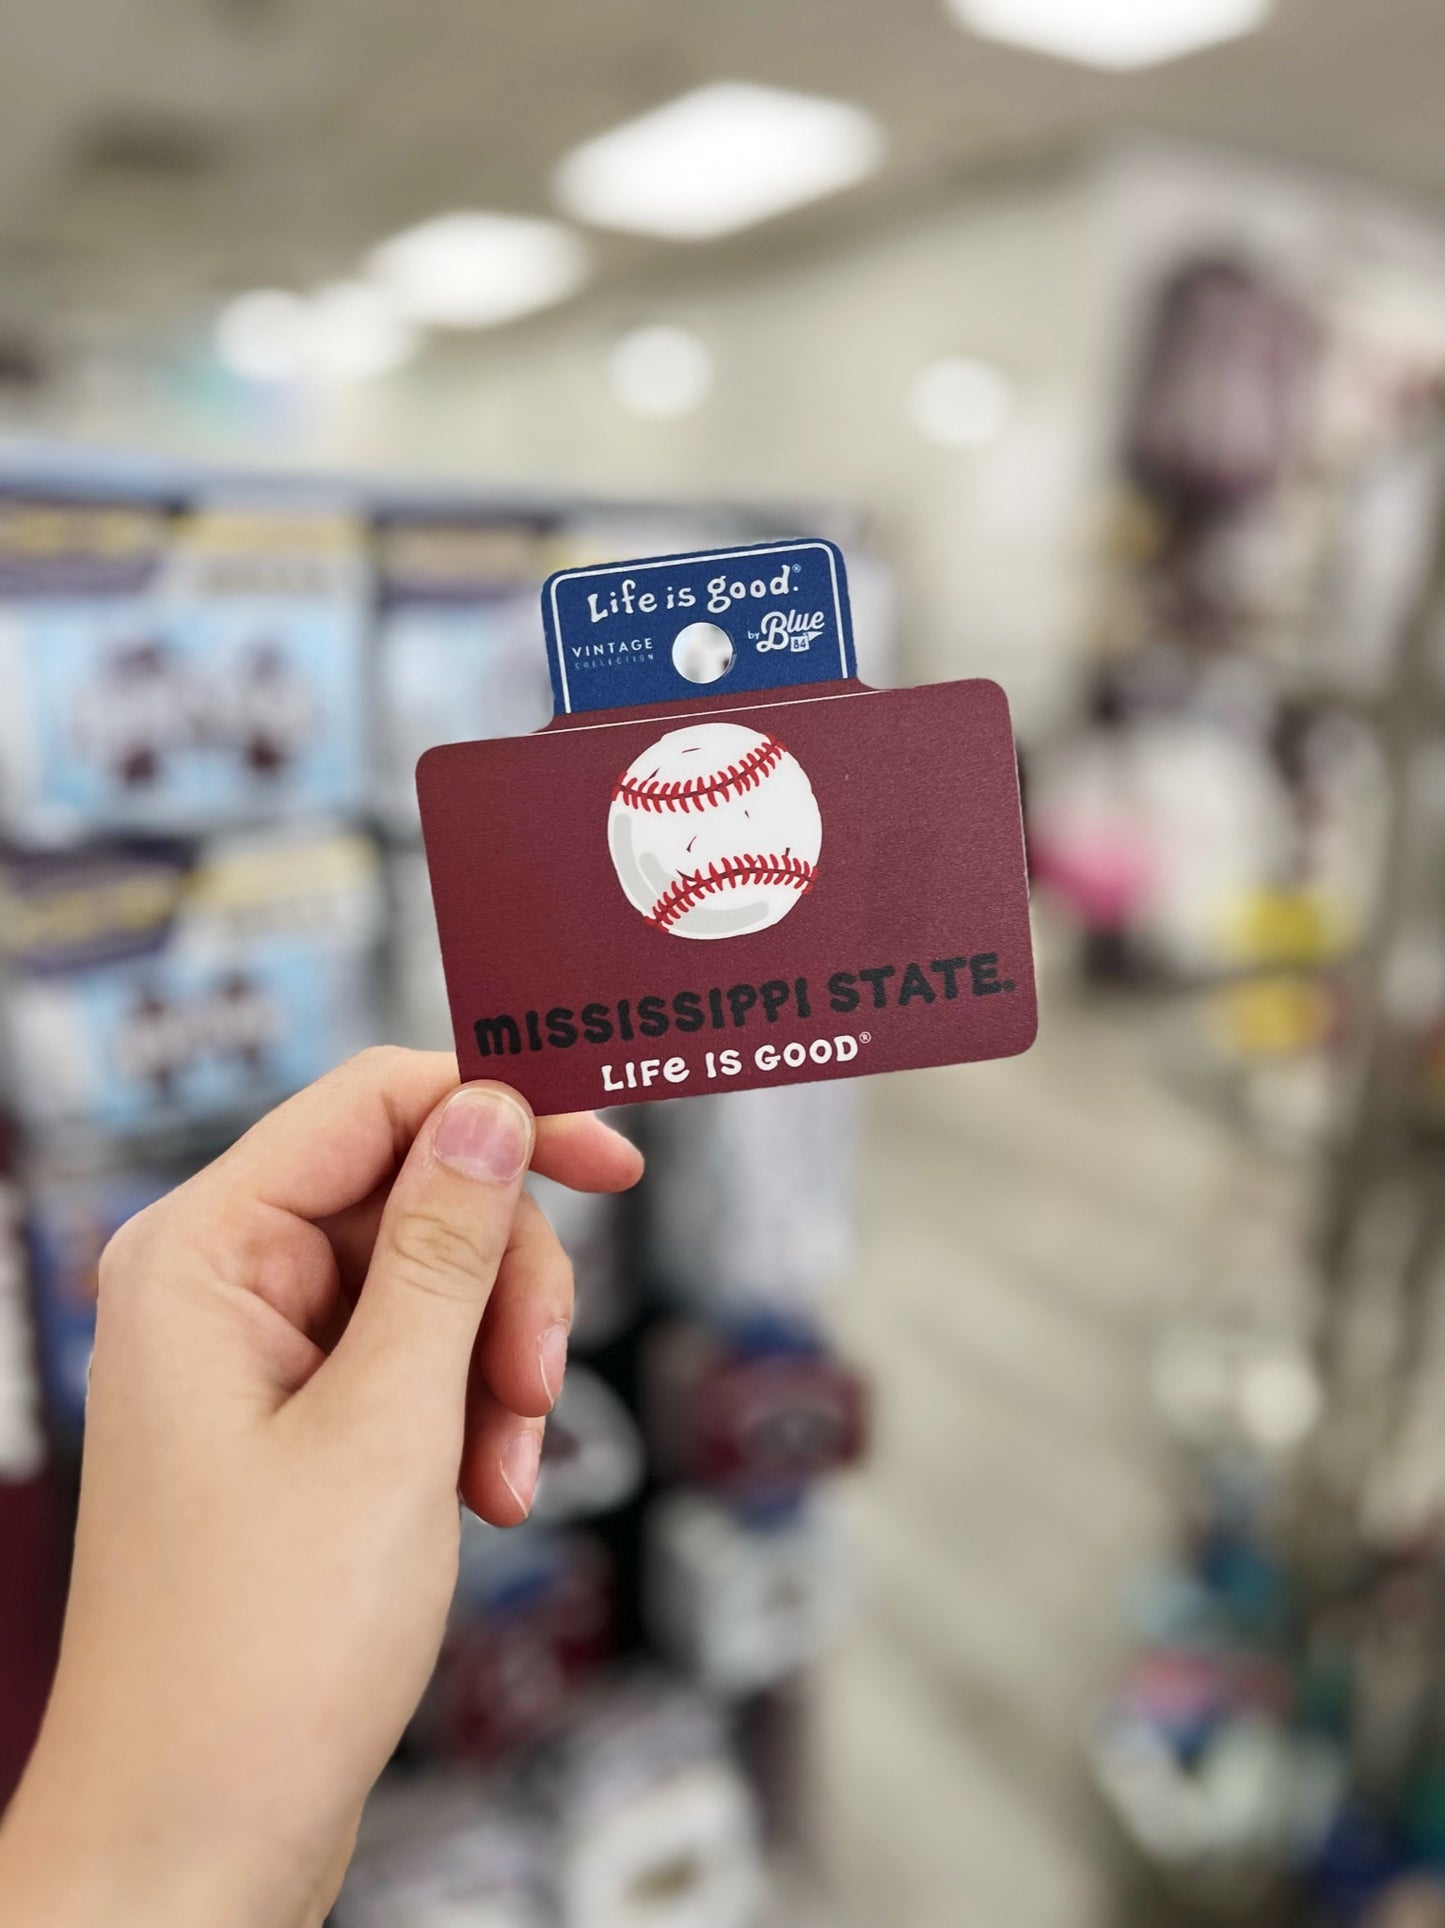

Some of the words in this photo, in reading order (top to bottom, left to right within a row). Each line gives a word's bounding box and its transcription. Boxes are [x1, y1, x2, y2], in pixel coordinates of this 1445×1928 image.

[588, 579, 657, 623] Life
[666, 586, 696, 609] is
[747, 631, 760, 640] by
[756, 609, 826, 652] Blue
[792, 638, 807, 650] 84
[572, 637, 653, 658] VINTAGE
[706, 1049, 742, 1080] IS
